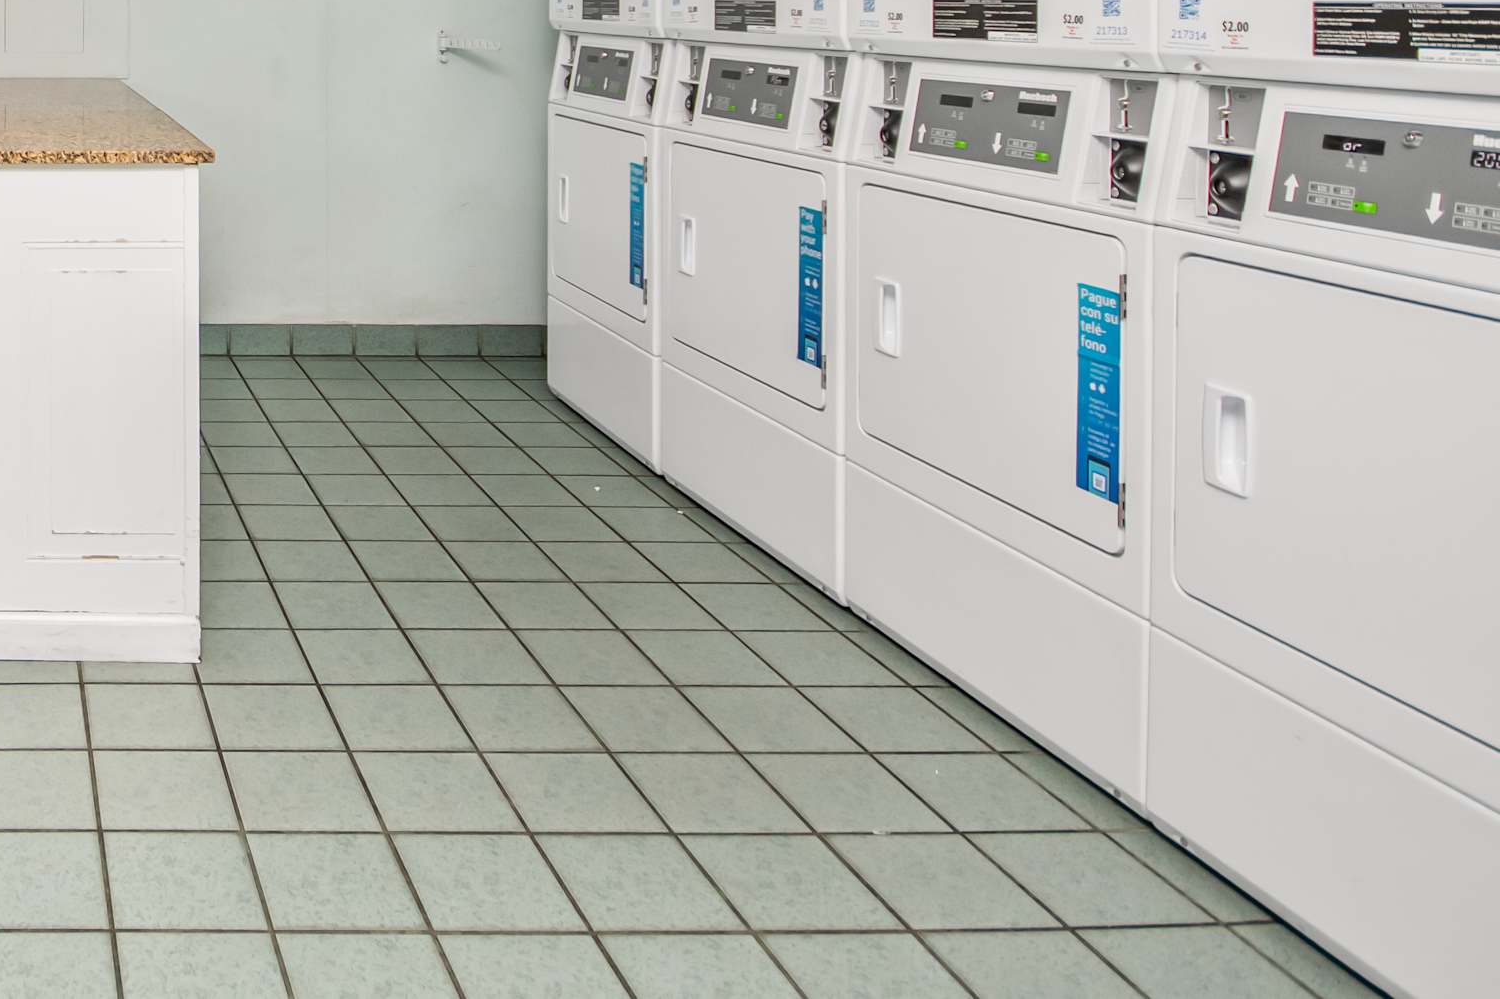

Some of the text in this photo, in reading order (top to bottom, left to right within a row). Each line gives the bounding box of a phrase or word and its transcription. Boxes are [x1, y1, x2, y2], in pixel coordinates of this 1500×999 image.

[1063, 13, 1084, 24] $2.00
[1096, 26, 1128, 36] 217313
[1222, 20, 1249, 33] $2.00
[1171, 28, 1207, 41] 217314
[1081, 288, 1117, 308] Pague
[1081, 306, 1119, 325] con su
[1081, 335, 1107, 354] fono
